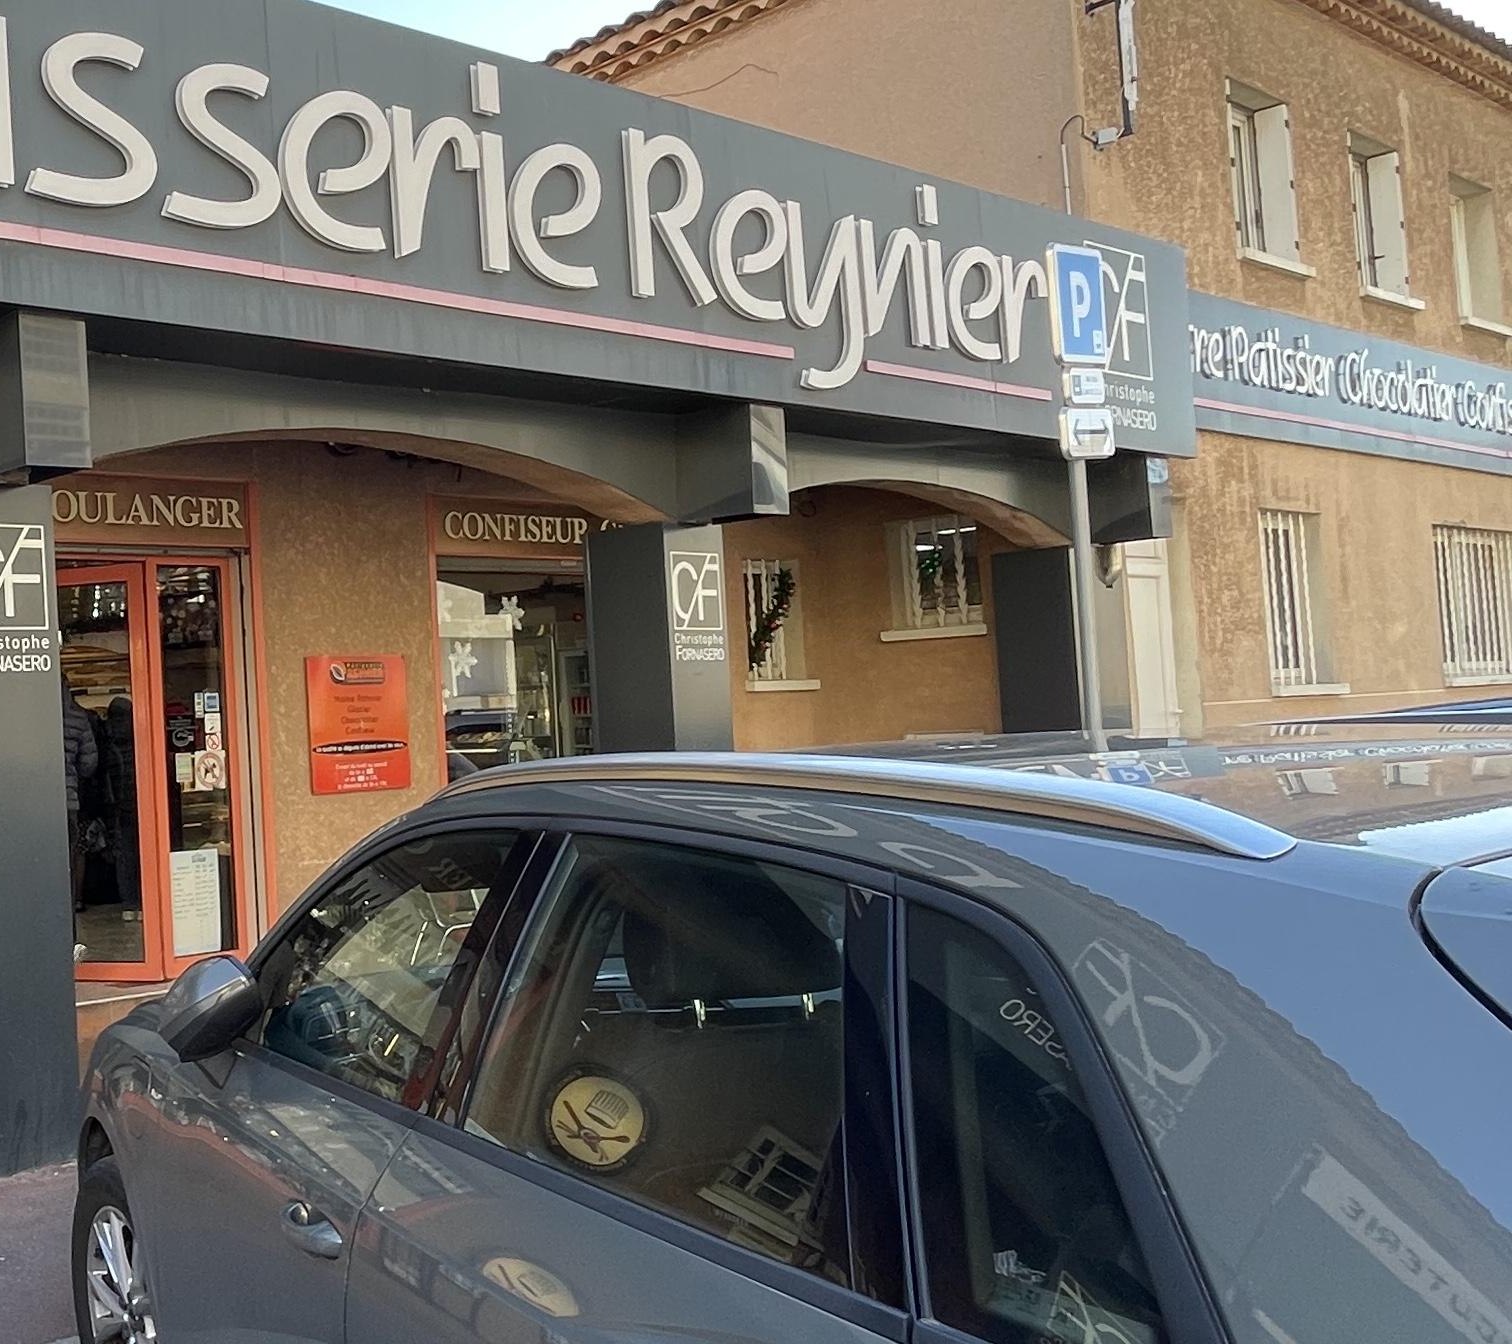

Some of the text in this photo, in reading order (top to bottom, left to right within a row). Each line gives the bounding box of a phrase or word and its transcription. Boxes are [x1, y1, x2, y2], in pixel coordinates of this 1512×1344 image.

[621, 127, 1048, 390] Reynier
[1069, 271, 1091, 338] P
[1229, 325, 1336, 397] Patissier
[1341, 348, 1457, 422] Chocolatier
[52, 489, 244, 529] OULANGER
[674, 632, 724, 646] Christophe
[675, 645, 725, 661] FORNASERO
